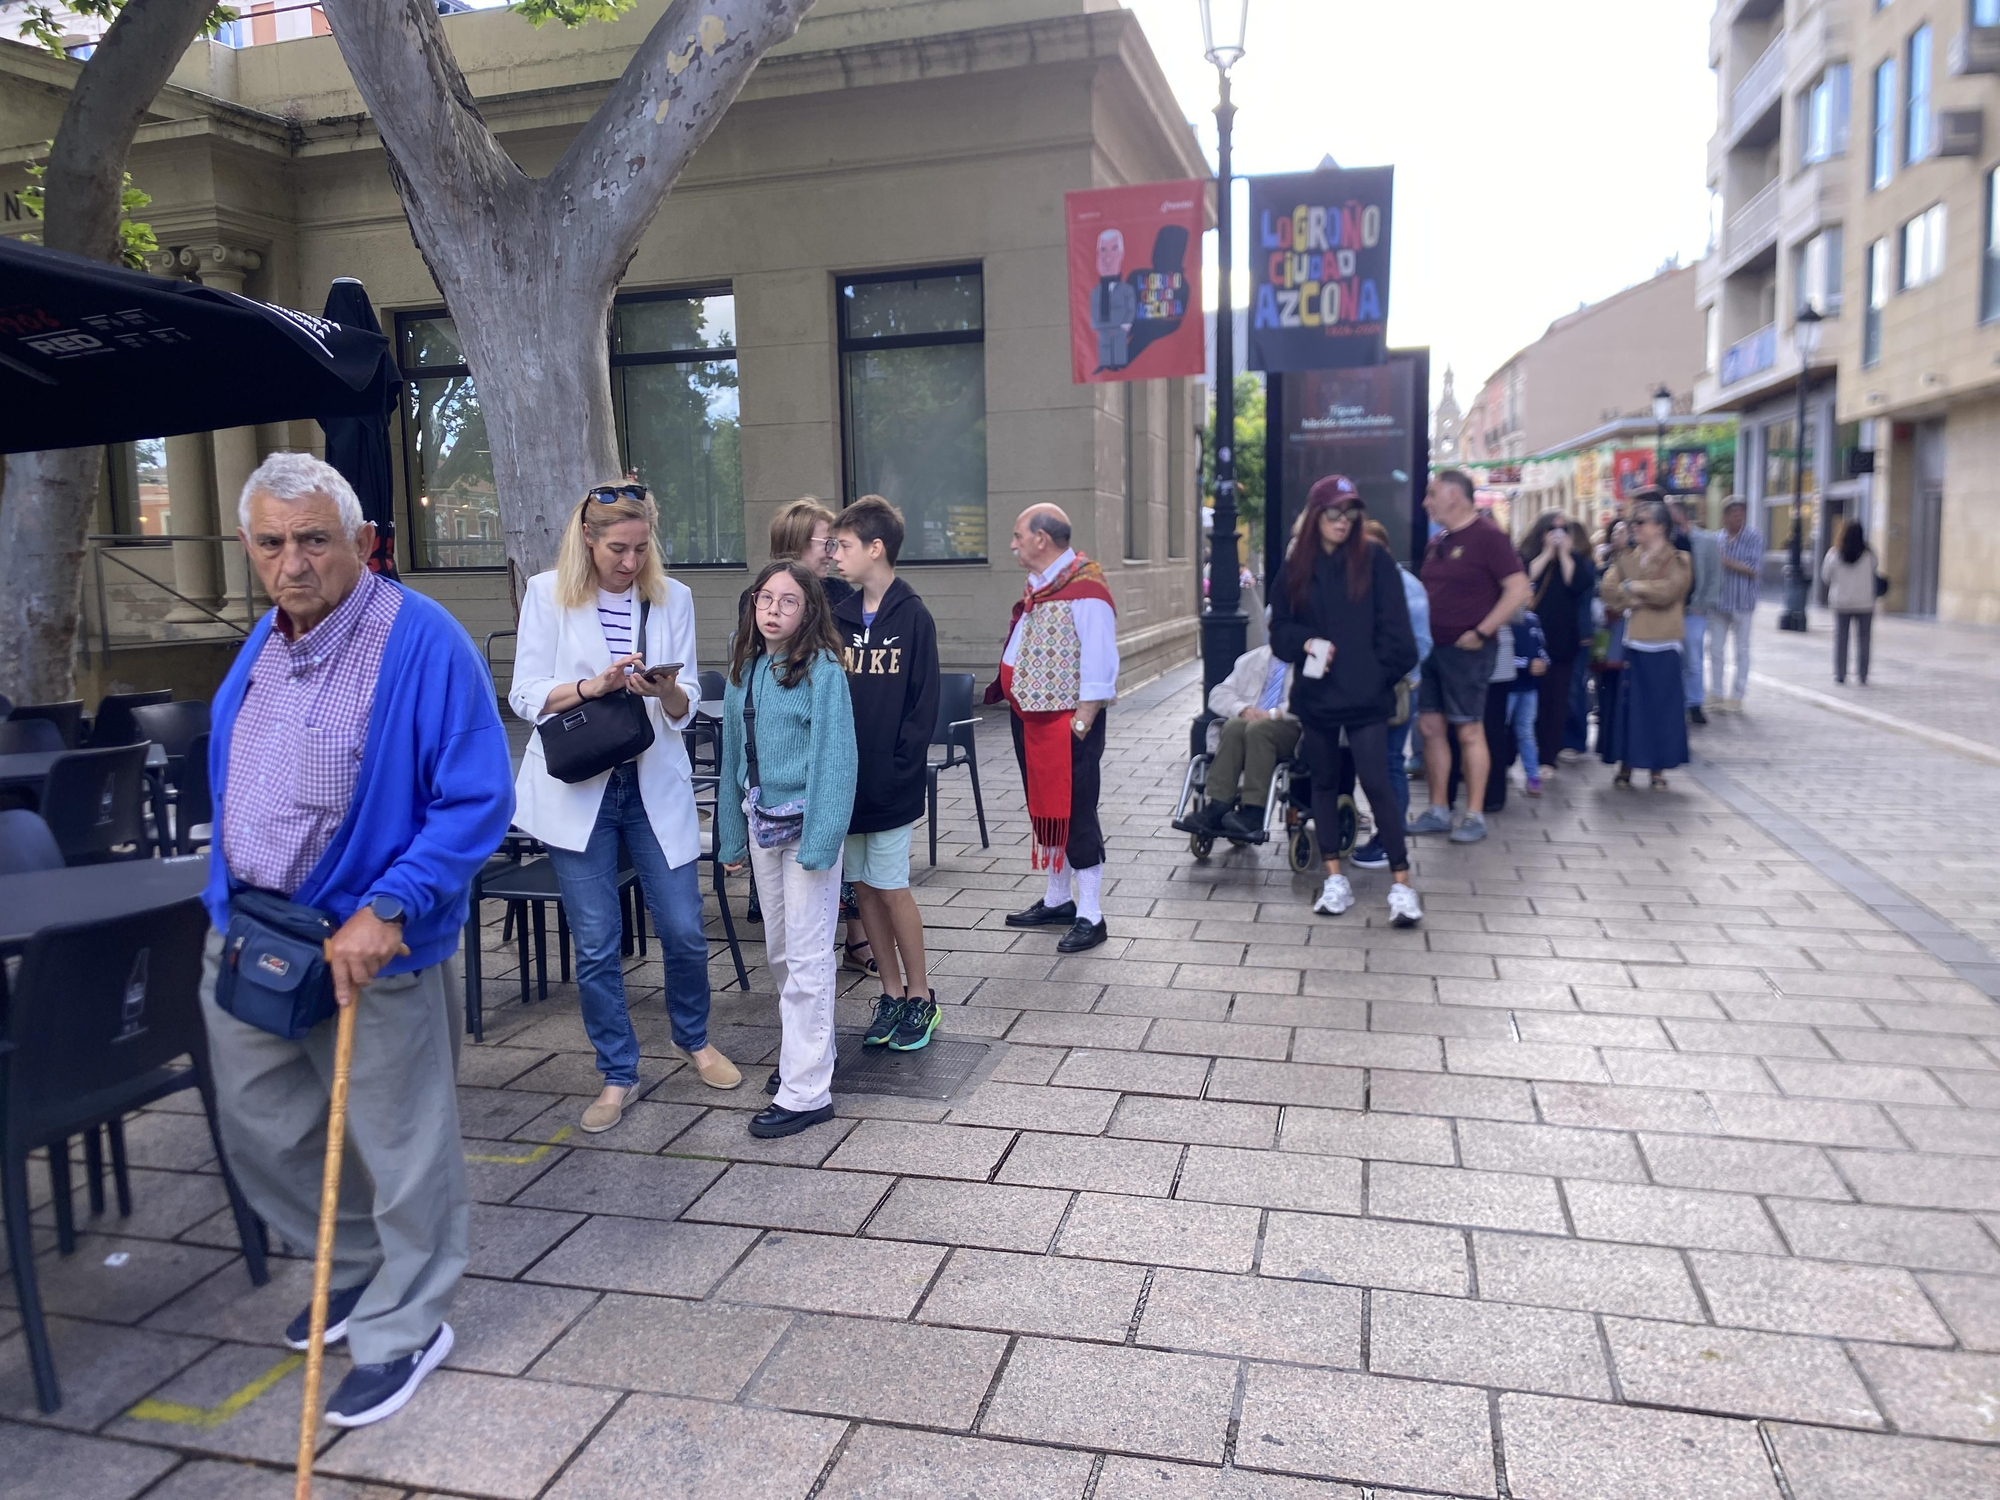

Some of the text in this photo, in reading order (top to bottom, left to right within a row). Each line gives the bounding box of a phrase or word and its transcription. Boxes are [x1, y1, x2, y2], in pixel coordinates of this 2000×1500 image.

[1260, 200, 1380, 252] LOGROÑO
[1137, 299, 1184, 319] AZCONA
[1253, 276, 1381, 330] AZCONA
[26, 333, 104, 355] RED
[843, 646, 902, 675] NIKE
